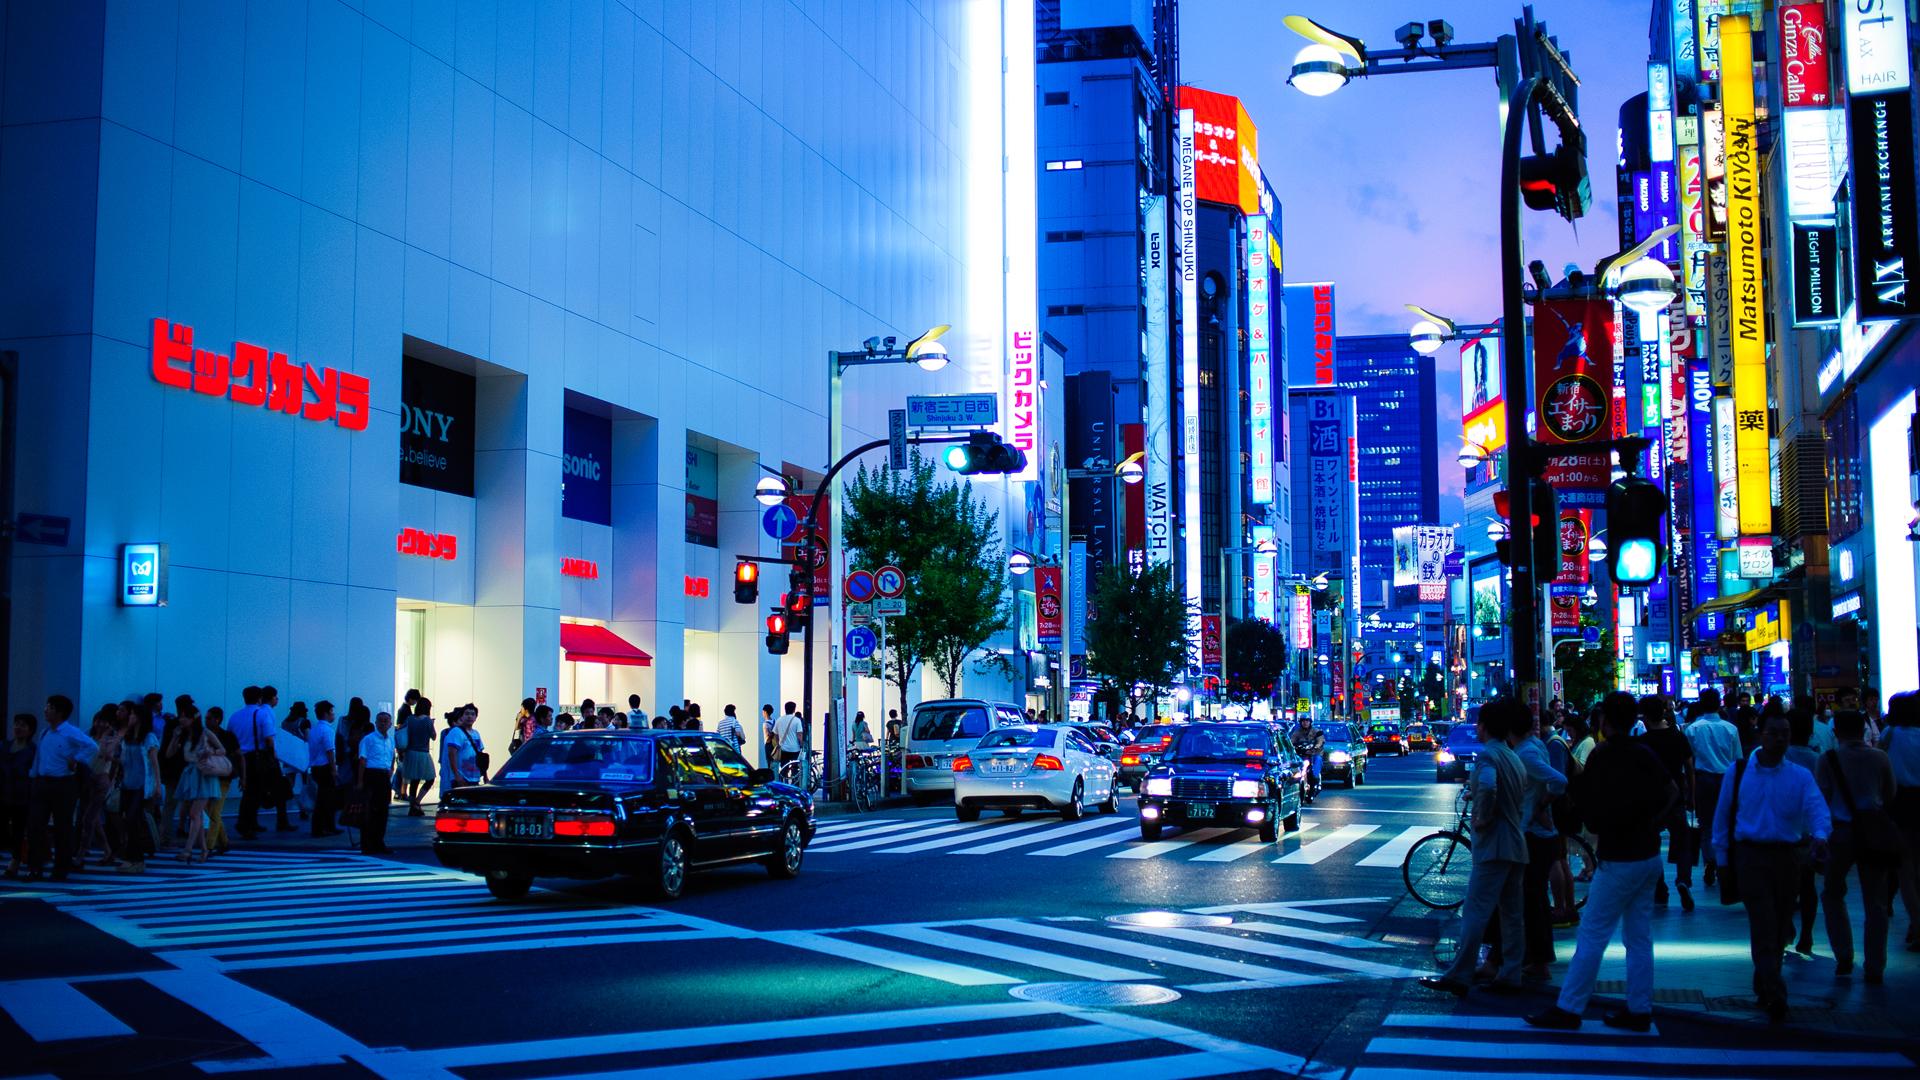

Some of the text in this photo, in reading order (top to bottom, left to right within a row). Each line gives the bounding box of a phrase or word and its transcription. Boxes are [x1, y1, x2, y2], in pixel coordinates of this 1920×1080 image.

[1784, 8, 1806, 103] Ginza Calla
[1861, 71, 1897, 85] HAIR
[1812, 93, 1826, 102] 4F
[1875, 100, 1895, 247] ARMANI EXCHANGE
[1182, 137, 1195, 281] MEGANE TOP SHINJUKU
[1738, 206, 1758, 341] Matsumoto
[150, 317, 371, 431] ビックカメラ
[1014, 331, 1032, 451] ビックカメラ
[1556, 382, 1581, 395] 新宿
[1693, 371, 1712, 413] AOKI
[911, 400, 990, 414] 新宿三丁目西
[1314, 399, 1335, 418] B1
[926, 414, 957, 423] Shinjuku
[958, 414, 964, 422] 3
[1561, 413, 1597, 433] まつり
[1738, 410, 1765, 431] 薬
[1312, 424, 1339, 453] 酒
[1419, 529, 1453, 550] カラオケ
[1432, 550, 1440, 562] の
[1073, 553, 1083, 645] DIAMOND SHIRAISHI
[1193, 808, 1214, 817] 71-72
[513, 823, 542, 836] 18-03
